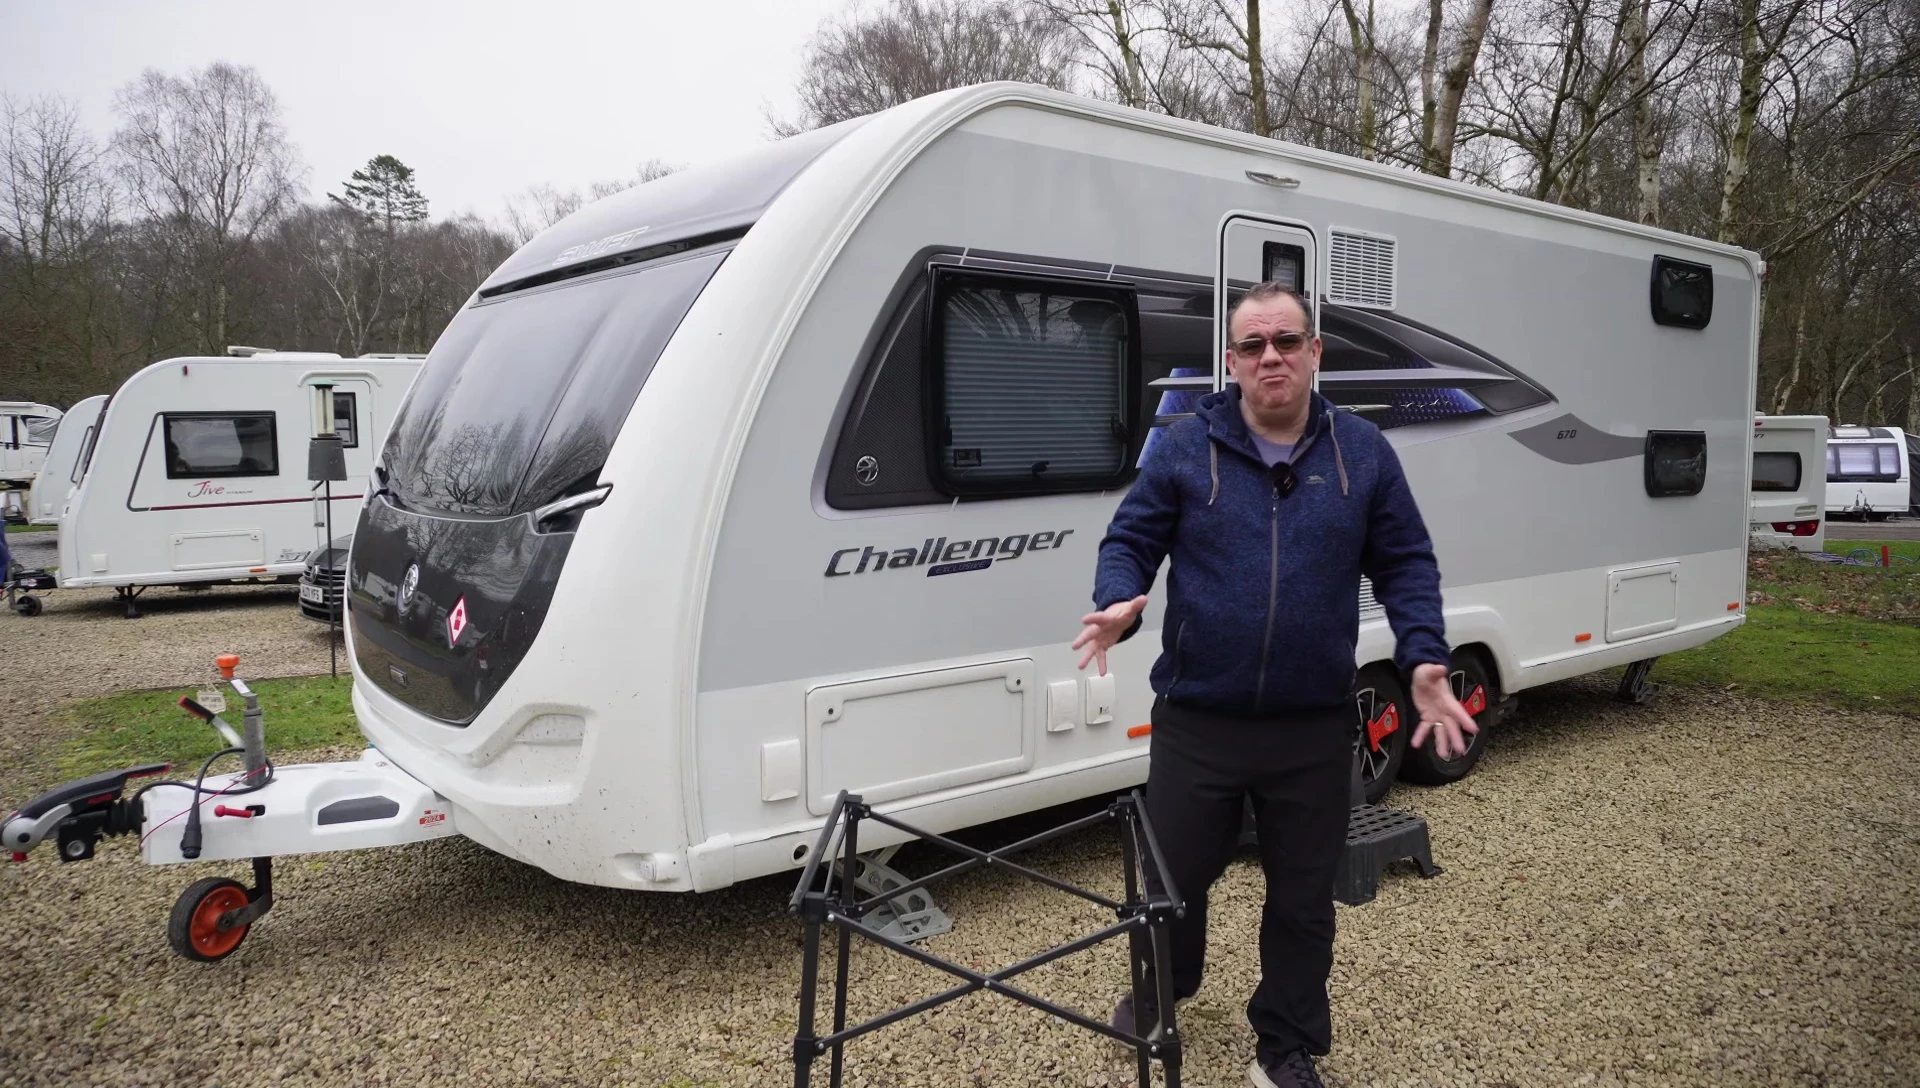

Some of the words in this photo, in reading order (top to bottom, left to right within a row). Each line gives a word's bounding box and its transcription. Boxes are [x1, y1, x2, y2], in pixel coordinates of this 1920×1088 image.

[1556, 429, 1577, 439] 670
[188, 480, 225, 498] Jive
[824, 529, 1075, 577] Challenger
[935, 561, 985, 574] EXCLUSIVE
